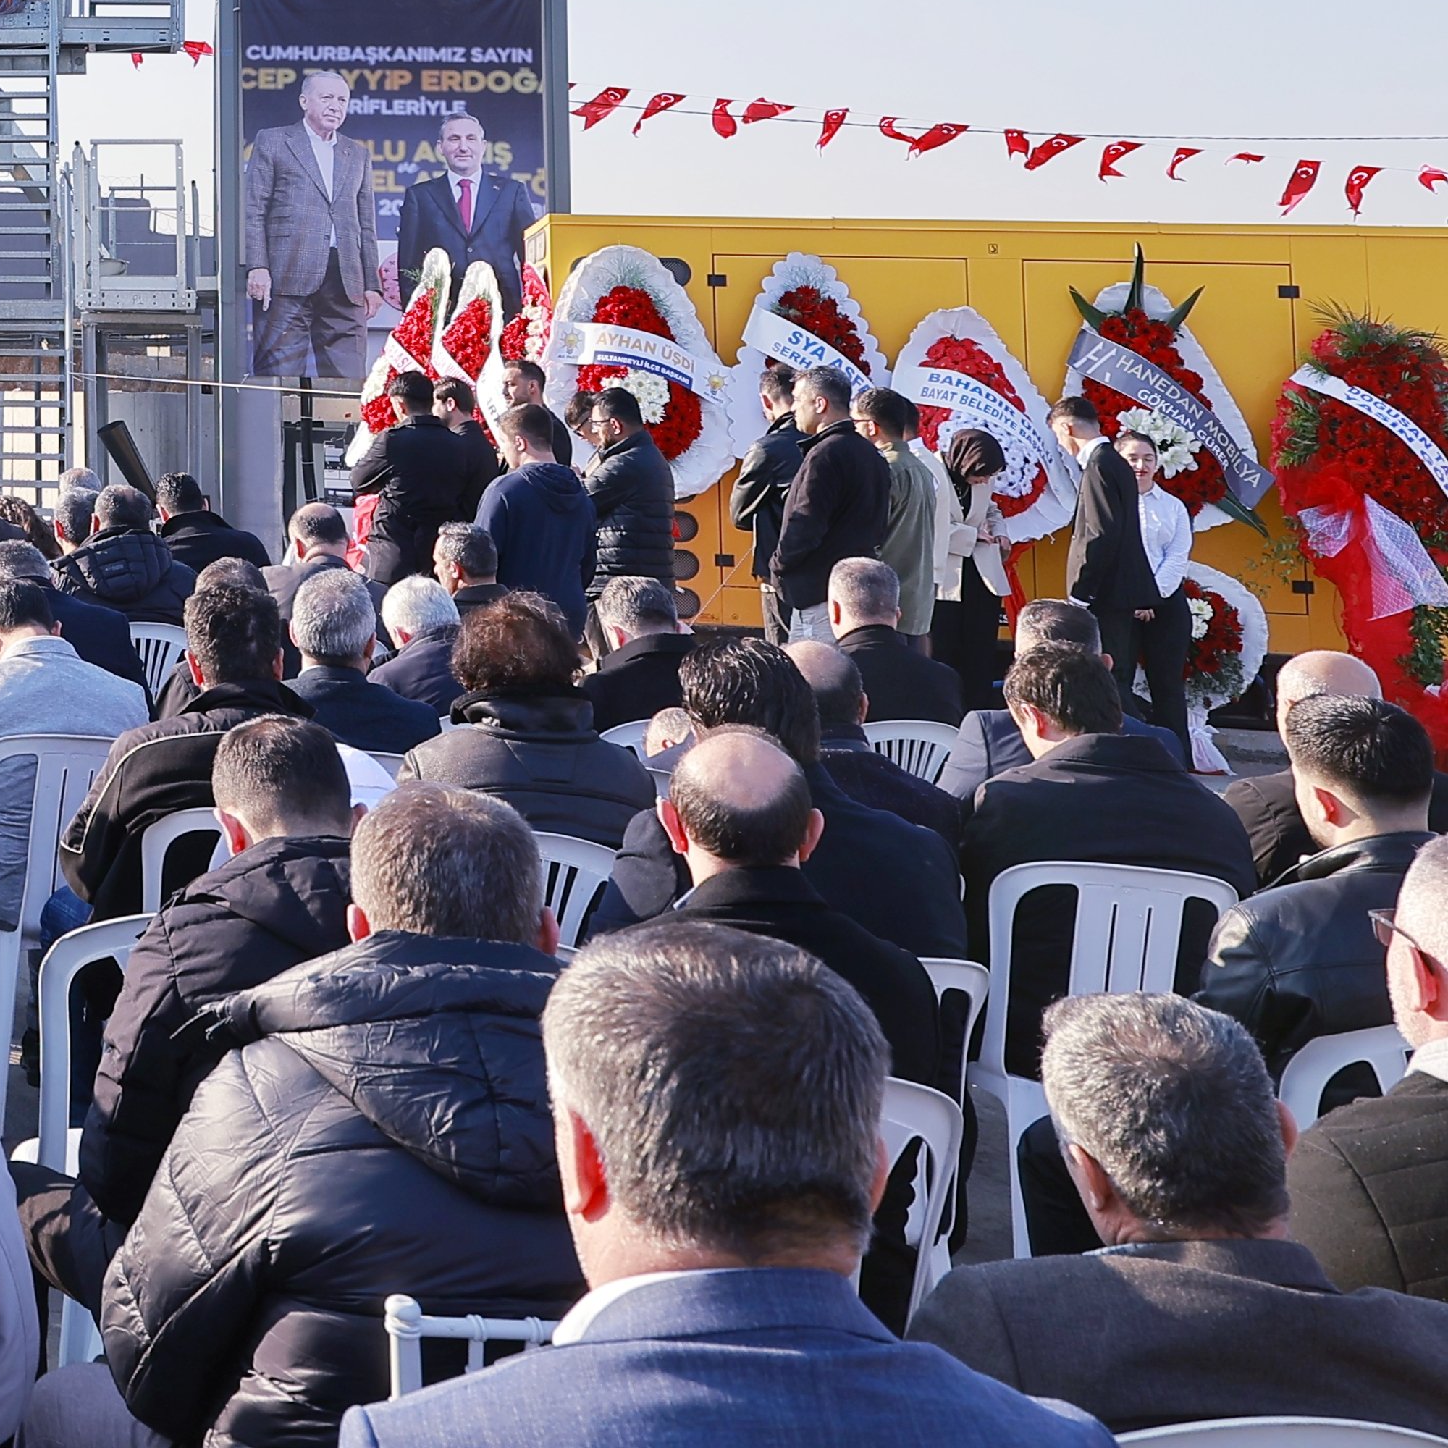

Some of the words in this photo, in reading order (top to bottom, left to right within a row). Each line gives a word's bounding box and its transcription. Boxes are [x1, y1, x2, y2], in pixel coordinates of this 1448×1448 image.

[245, 45, 466, 65] CUMHURBAŞKANIMIZ
[470, 48, 533, 63] SAYIN
[421, 67, 544, 93] ERDOĞ
[348, 96, 467, 116] RİFLERİYLE
[596, 331, 657, 356] AYHAN
[772, 341, 813, 369] SERH
[788, 331, 826, 361] SYA
[927, 372, 1016, 417] BAHADIR
[1115, 354, 1203, 420] HANEDAN
[920, 386, 958, 401] BAYAT
[958, 395, 1018, 432] BELEDİYE
[1137, 388, 1196, 430] GÖKHAN
